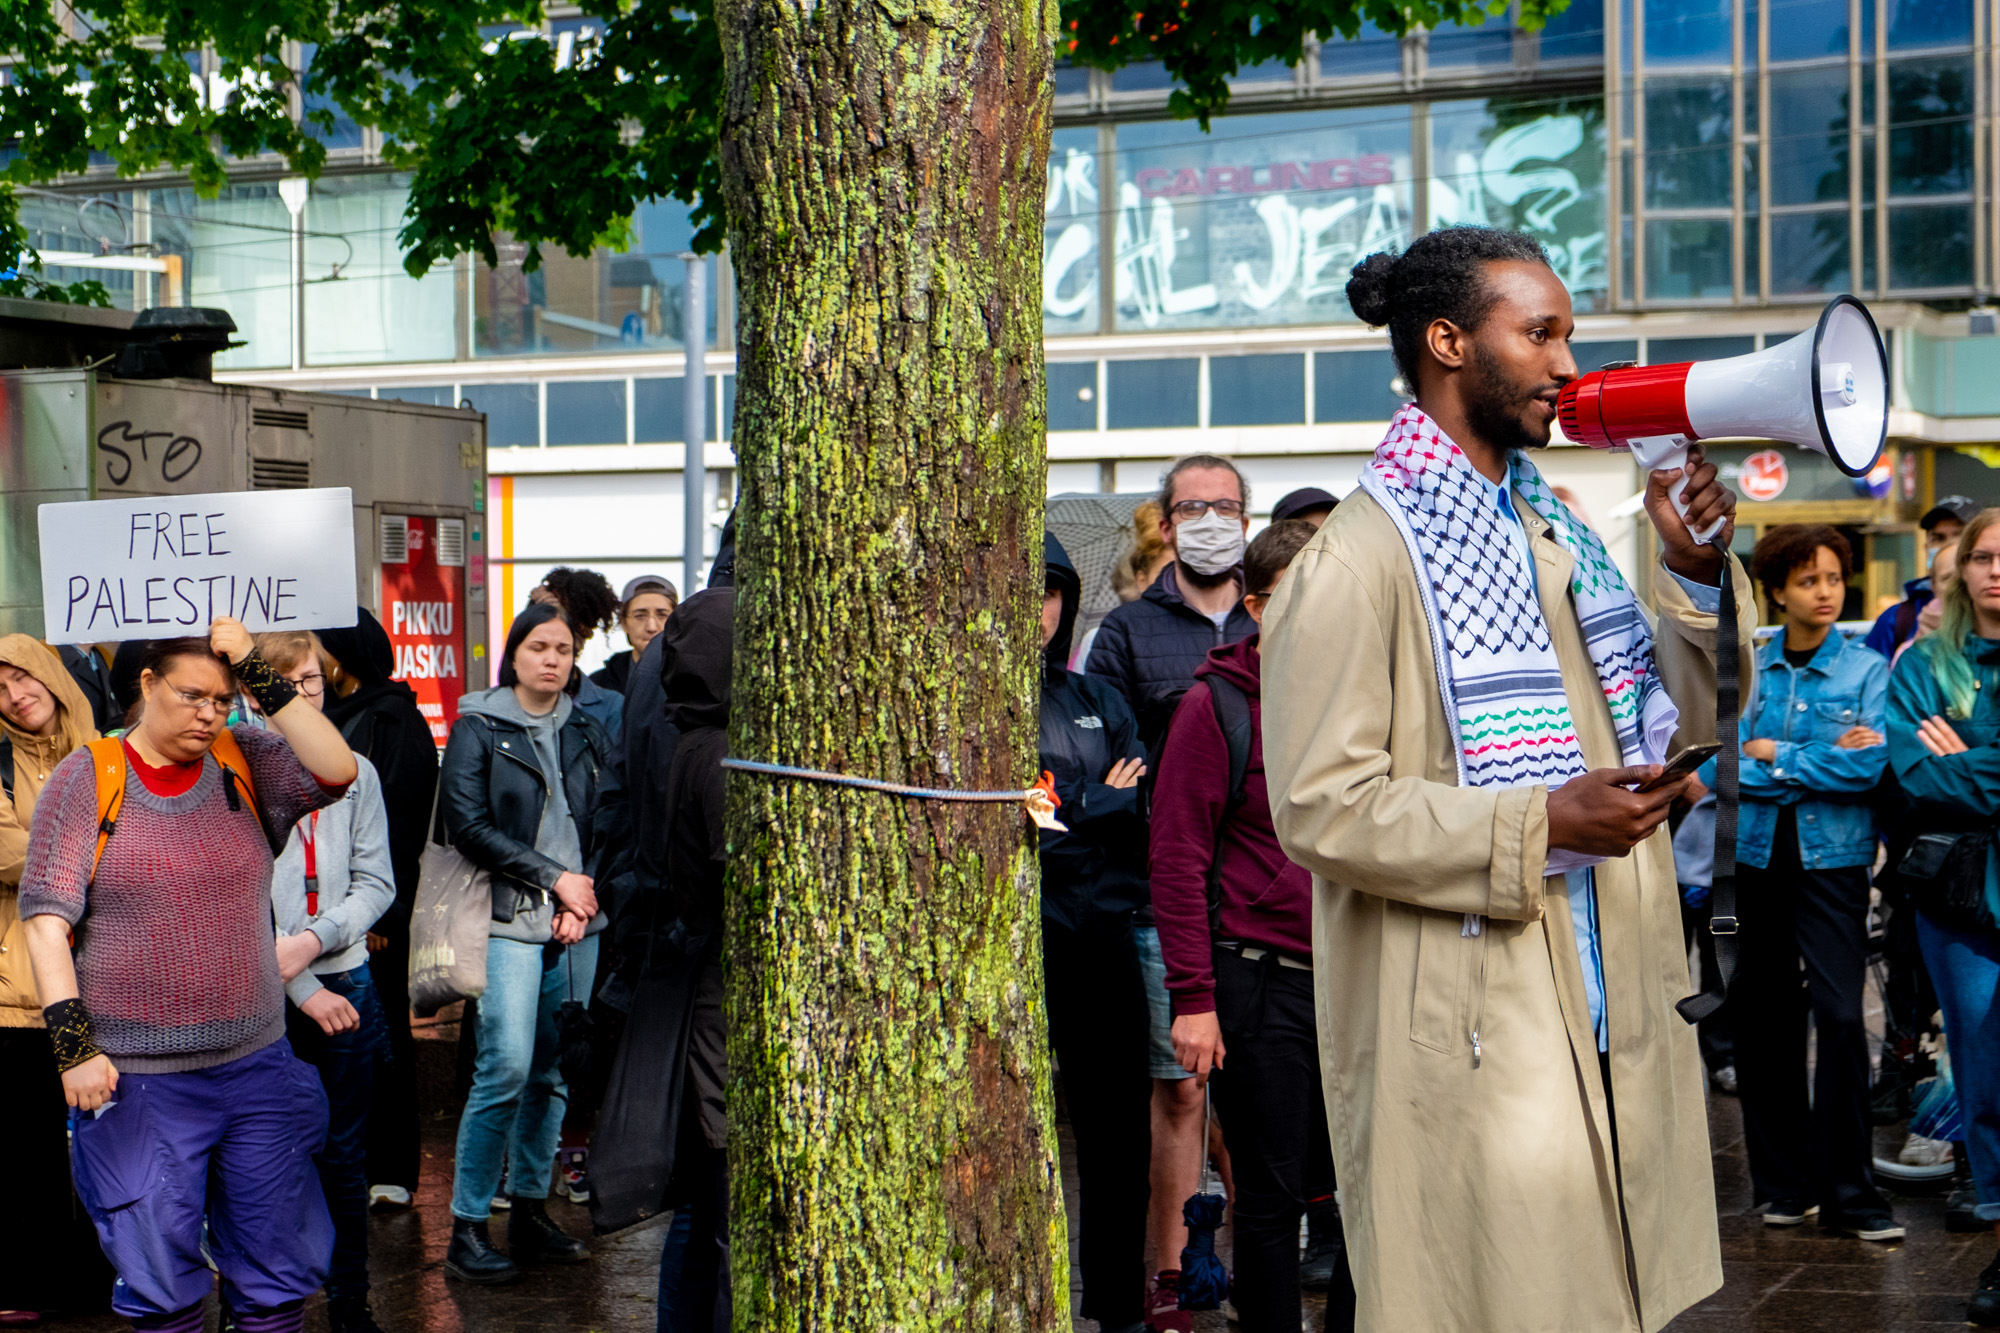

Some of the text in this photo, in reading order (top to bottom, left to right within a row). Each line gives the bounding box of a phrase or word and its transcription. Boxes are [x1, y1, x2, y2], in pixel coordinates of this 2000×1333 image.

[1134, 154, 1396, 199] CARLINGS
[128, 511, 232, 561] FREE
[65, 575, 299, 632] PALESTINE
[392, 601, 453, 636] PIKKU
[391, 644, 458, 680] JASKA
